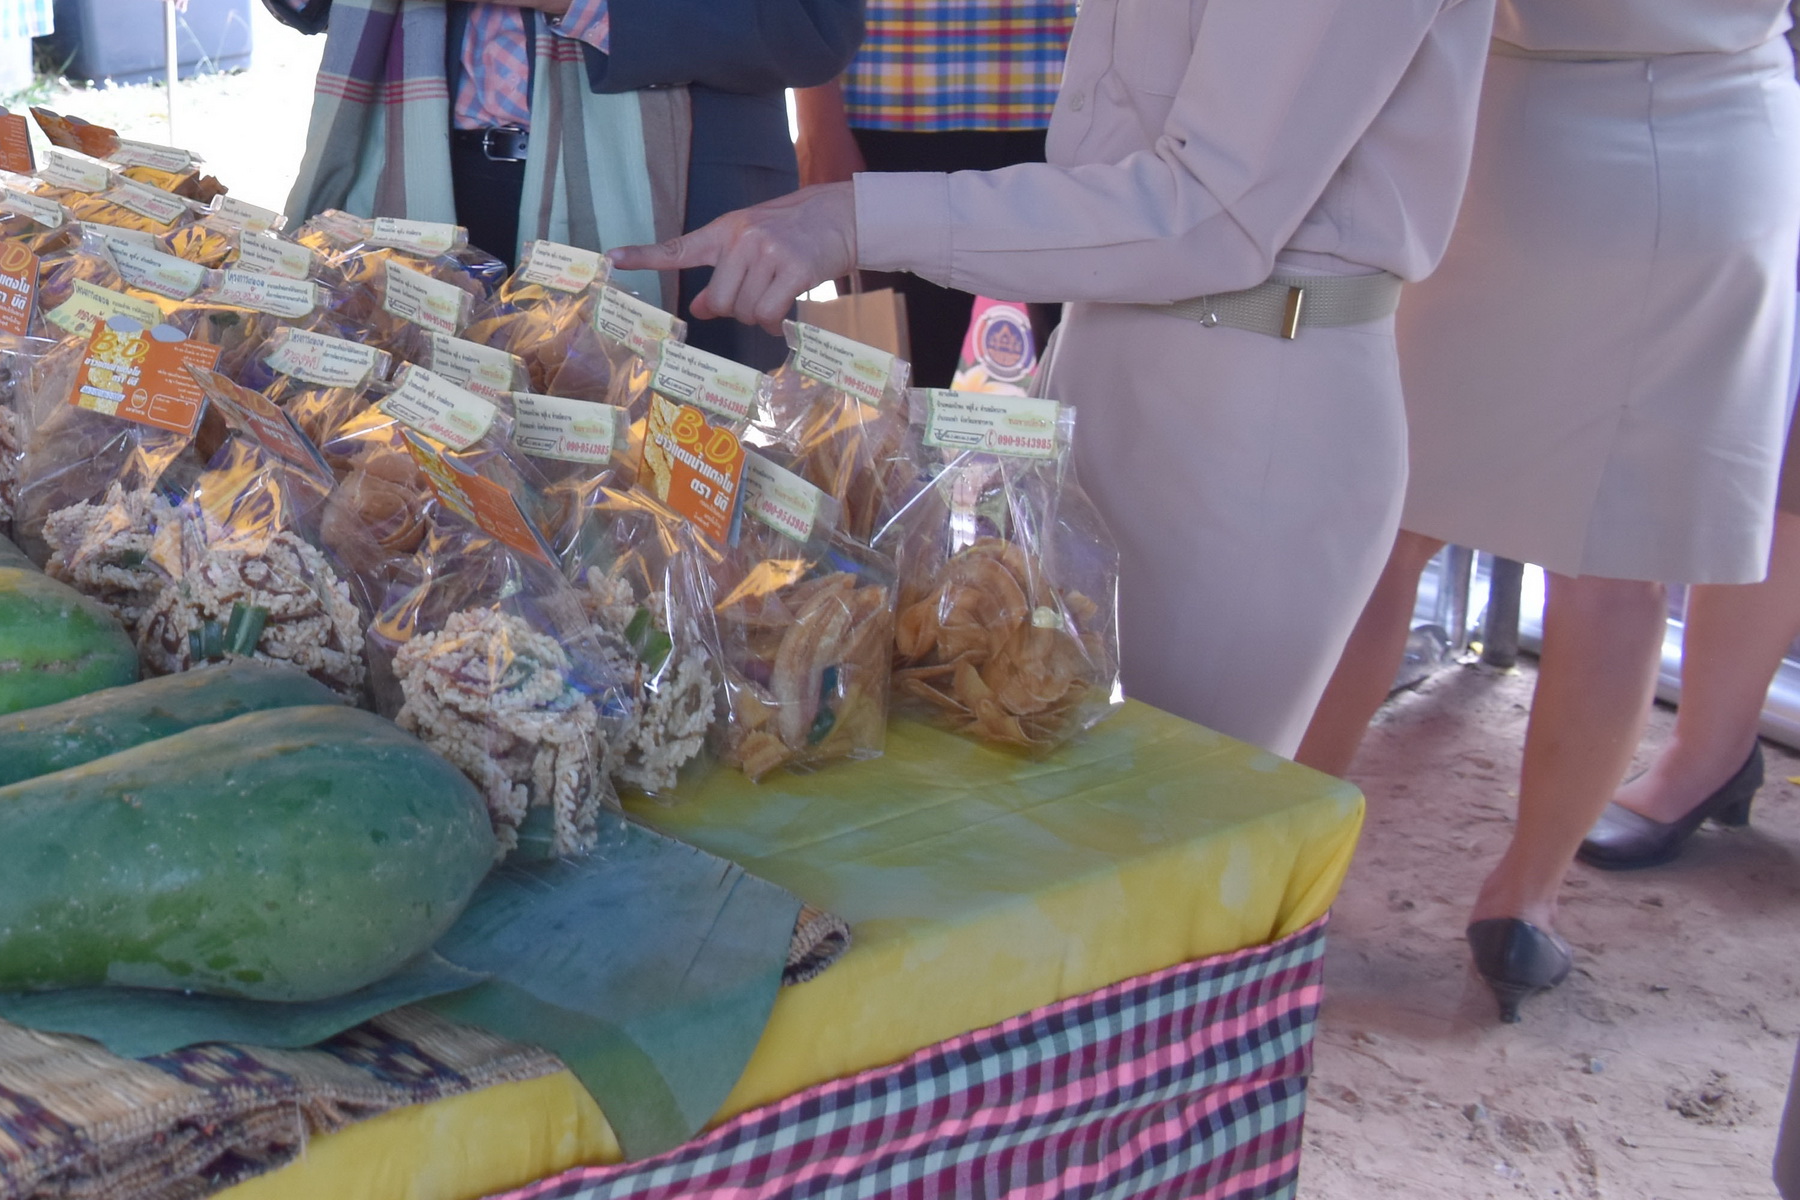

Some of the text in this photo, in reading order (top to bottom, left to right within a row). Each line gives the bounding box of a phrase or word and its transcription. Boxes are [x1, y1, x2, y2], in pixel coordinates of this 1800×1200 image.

[671, 405, 739, 474] B.D.
[997, 434, 1052, 450] 090-9543985
[690, 477, 711, 500] ตรา
